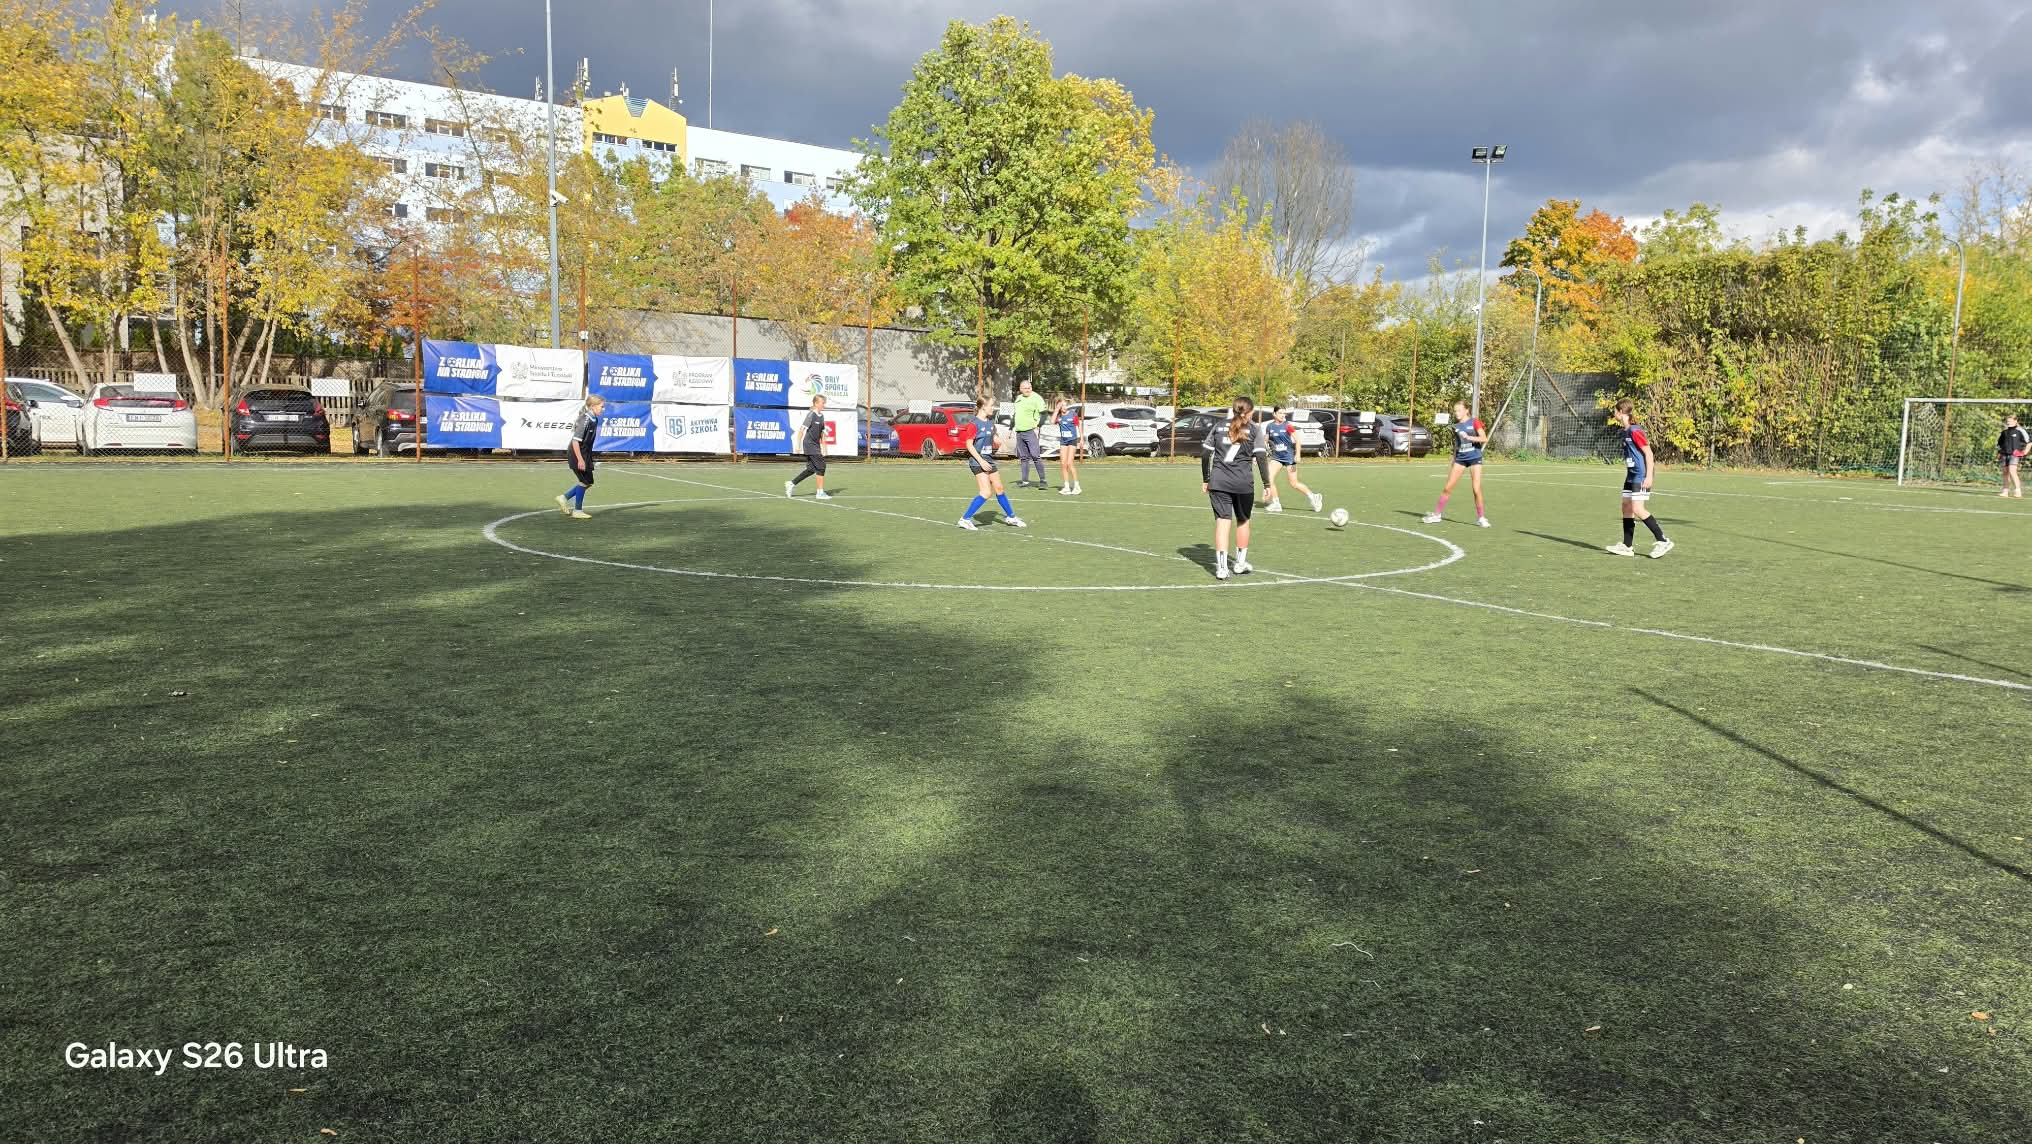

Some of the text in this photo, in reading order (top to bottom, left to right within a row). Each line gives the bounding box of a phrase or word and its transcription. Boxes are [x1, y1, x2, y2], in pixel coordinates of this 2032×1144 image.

[438, 356, 483, 369] Z ORLIKA
[437, 367, 489, 379] NA STADION
[601, 366, 641, 377] Z ORLIKA
[600, 375, 647, 387] NA STADION
[443, 411, 487, 422] Z ORLIKA
[440, 421, 494, 433] NA STADION
[601, 417, 640, 428] Z ORLIKA
[600, 426, 647, 437] NA STADION
